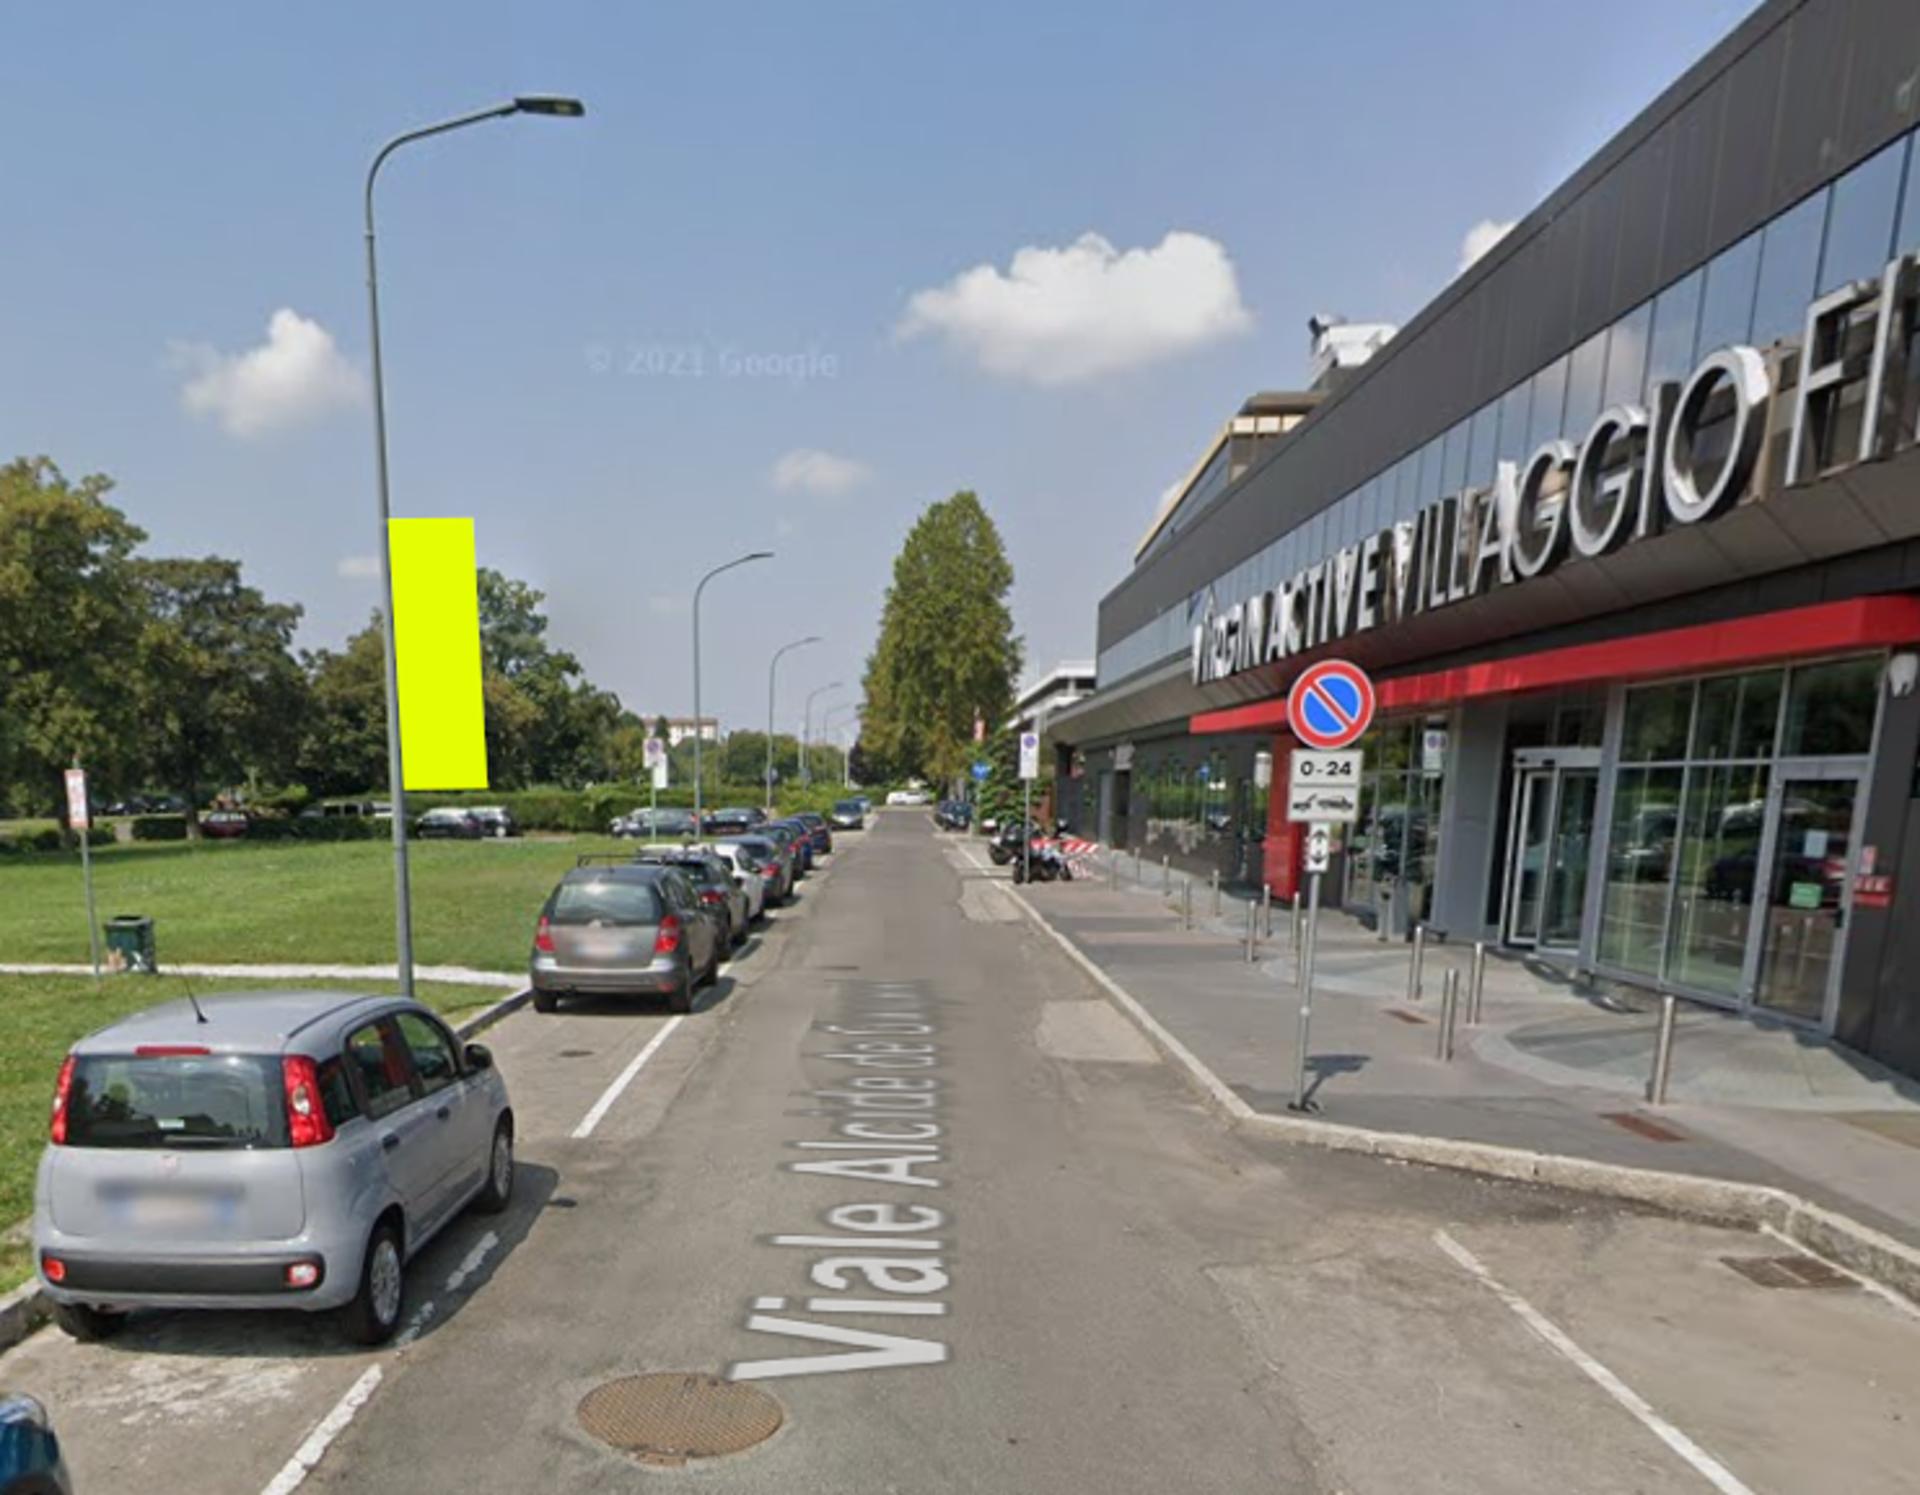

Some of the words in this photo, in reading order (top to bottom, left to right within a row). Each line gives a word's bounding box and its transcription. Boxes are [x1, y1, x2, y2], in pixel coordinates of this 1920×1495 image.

[1265, 533, 1380, 664] ACTIVE
[1393, 344, 1770, 622] VILLAGGIO
[1784, 250, 1920, 488] FI
